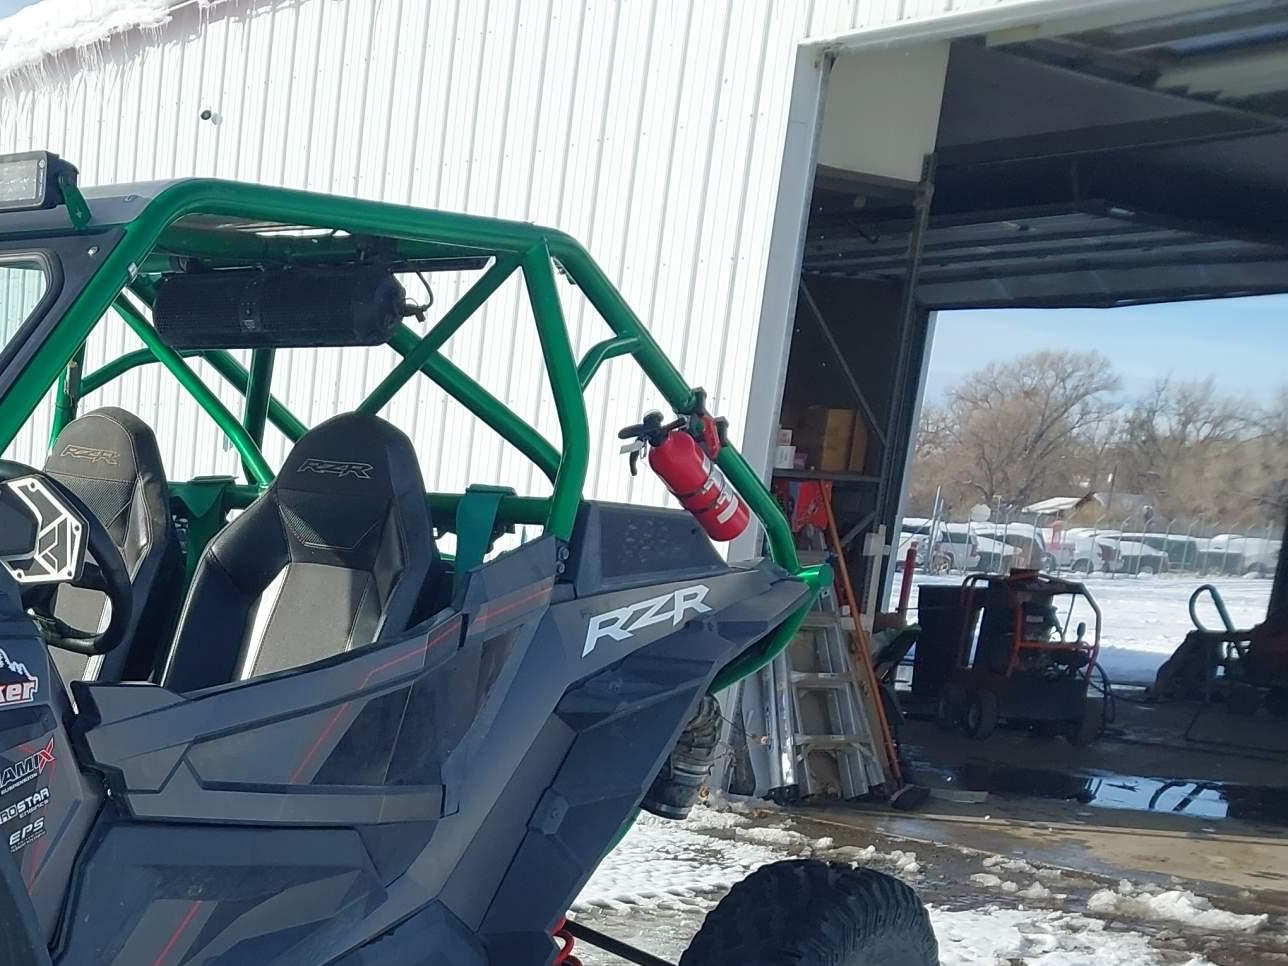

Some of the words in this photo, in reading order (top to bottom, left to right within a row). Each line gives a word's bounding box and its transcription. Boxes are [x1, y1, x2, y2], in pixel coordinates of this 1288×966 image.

[60, 444, 119, 465] RZR
[297, 458, 373, 479] RZR
[582, 584, 712, 658] RZR
[9, 817, 44, 846] EPS
